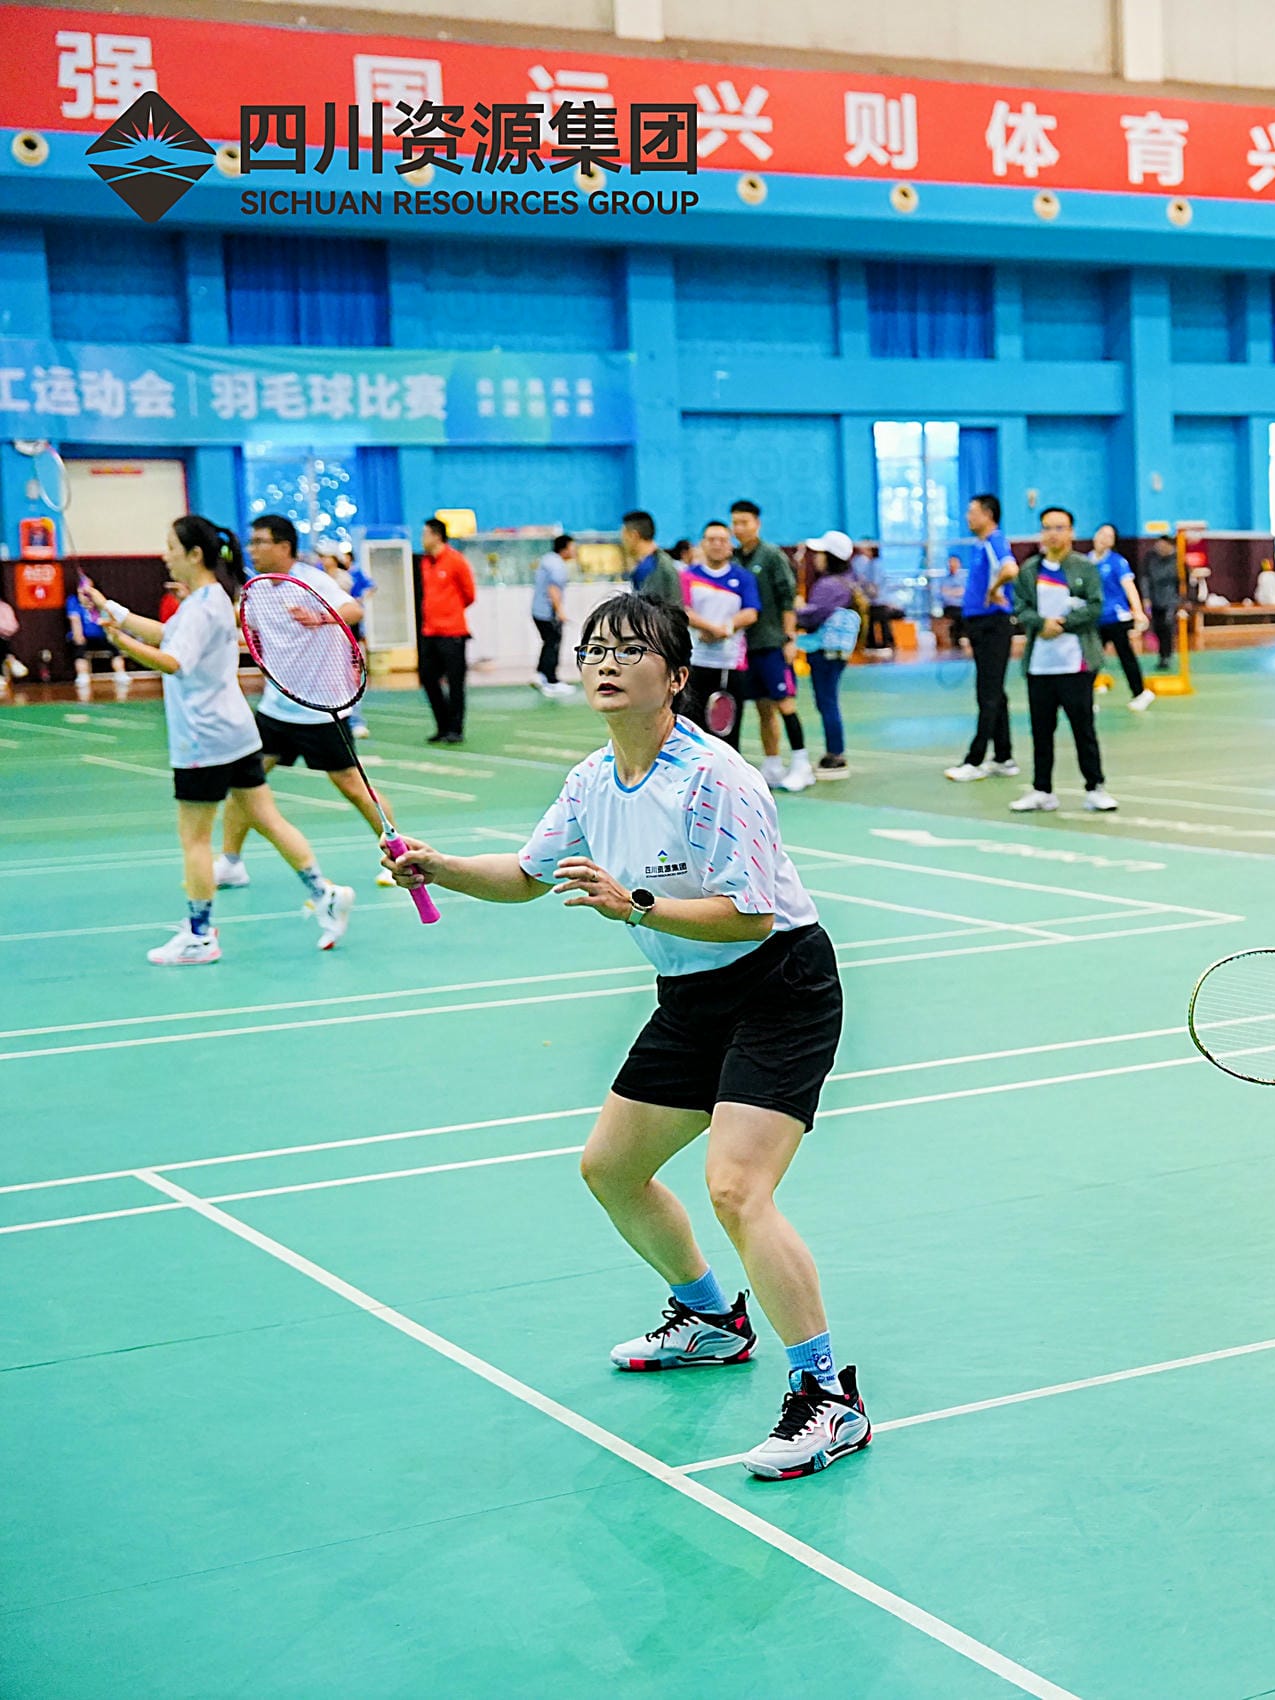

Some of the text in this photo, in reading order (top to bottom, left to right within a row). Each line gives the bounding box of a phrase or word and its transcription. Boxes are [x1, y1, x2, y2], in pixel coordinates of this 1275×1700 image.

[210, 371, 447, 420] 羽毛球比赛
